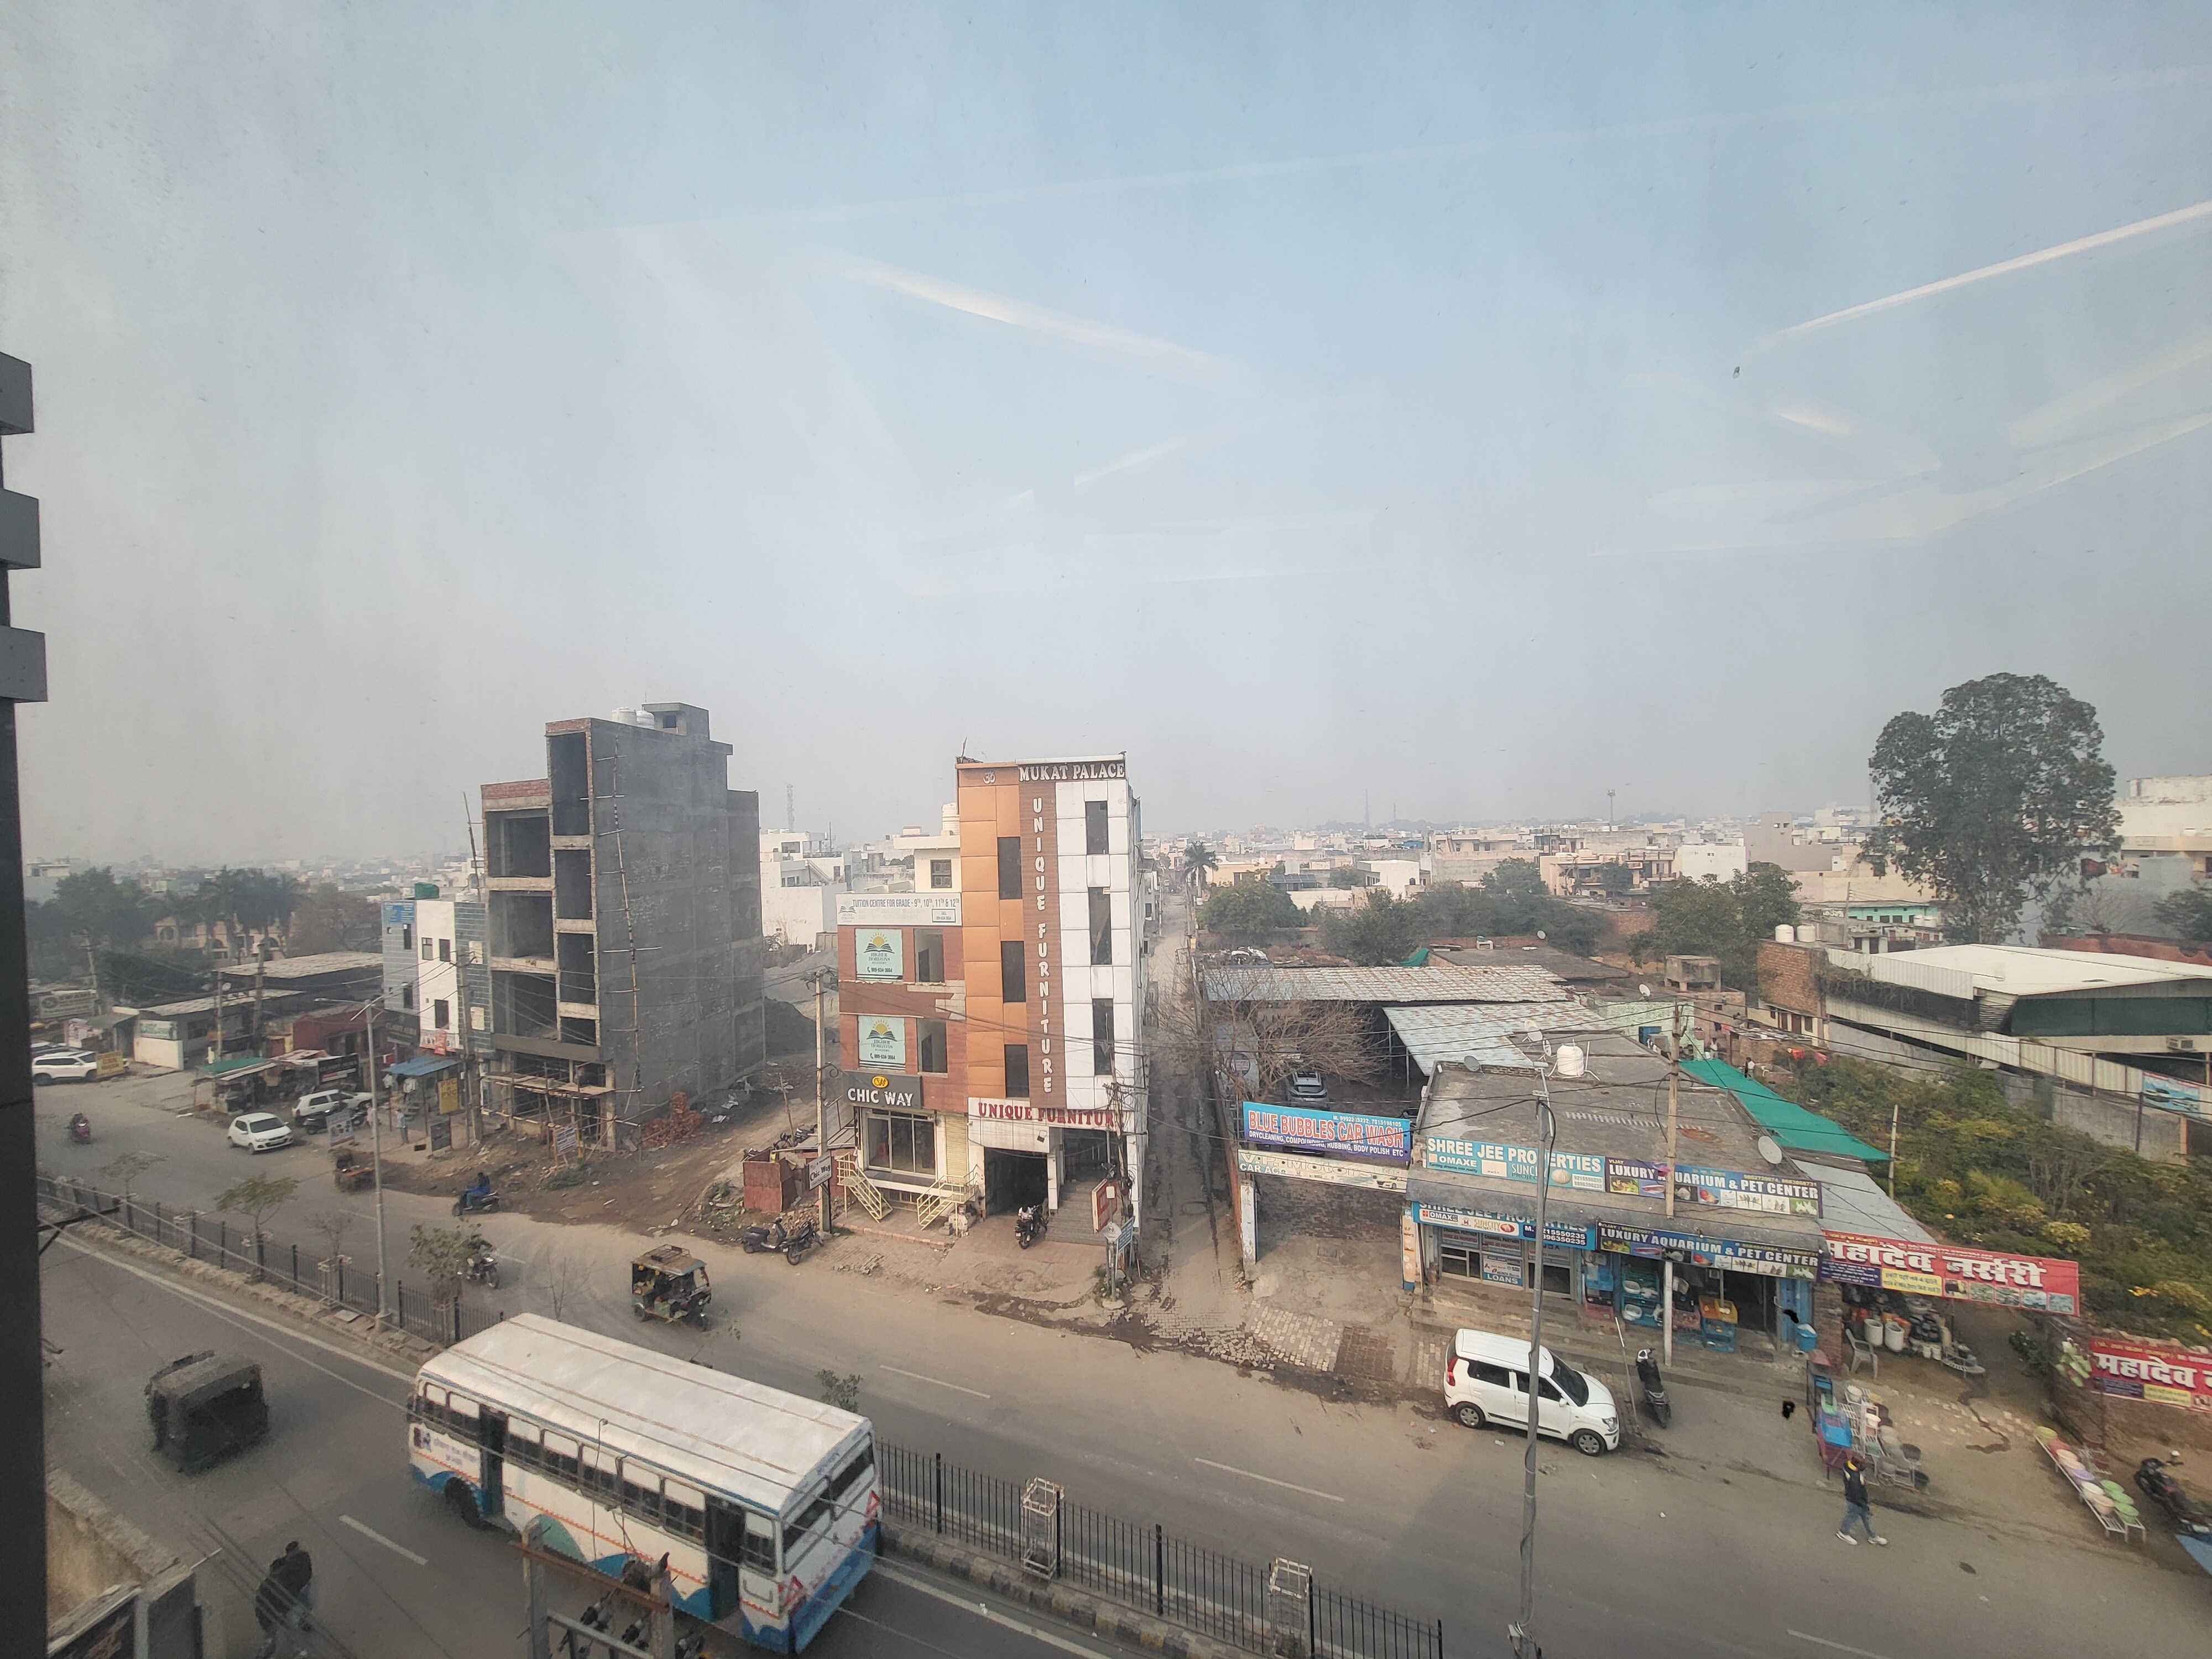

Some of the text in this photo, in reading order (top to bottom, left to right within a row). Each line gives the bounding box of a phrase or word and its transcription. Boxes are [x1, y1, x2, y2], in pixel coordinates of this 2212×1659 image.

[1019, 763, 1125, 781] MUKAT PALACE
[853, 899, 869, 907] TUITION
[870, 899, 886, 907] CENTRE
[887, 899, 895, 907] FOR
[896, 899, 910, 907] GRADE
[1033, 797, 1053, 1093] UNIQUE FURNITURE
[847, 1088, 913, 1107] CHIC WAY
[978, 1102, 1124, 1128] UNIQUE FURNITUR
[1248, 1110, 1404, 1149] BLUE BUBBLES CAR WASH
[1249, 1130, 1285, 1143] DRYCLEANING,
[1327, 1142, 1353, 1152] RUBBING,
[1354, 1145, 1369, 1153] BODY
[1370, 1147, 1390, 1156] POLISH
[1427, 1138, 1601, 1173] SHREE JEE PROERTIES
[1239, 1163, 1262, 1173] CAR
[1439, 1156, 1477, 1167] OMAXE
[1609, 1164, 1655, 1180] LUXURY
[1658, 1171, 1726, 1188] UARIUM
[1729, 1180, 1738, 1189] &
[1740, 1179, 1764, 1193] PET
[1767, 1182, 1818, 1199] CENTER
[1543, 1228, 1585, 1239] 215550235
[1601, 1228, 1648, 1243] LUXURY
[1651, 1235, 1721, 1254] AQUARIUM
[1725, 1246, 1734, 1255] &
[1738, 1247, 1762, 1259] PET
[1765, 1251, 1818, 1266] CENTER
[1825, 1240, 1936, 1272] महादेव
[1942, 1255, 2047, 1287] नर्सरी
[1487, 1273, 1519, 1285] LOANS
[2093, 1353, 2198, 1389] महादेव
